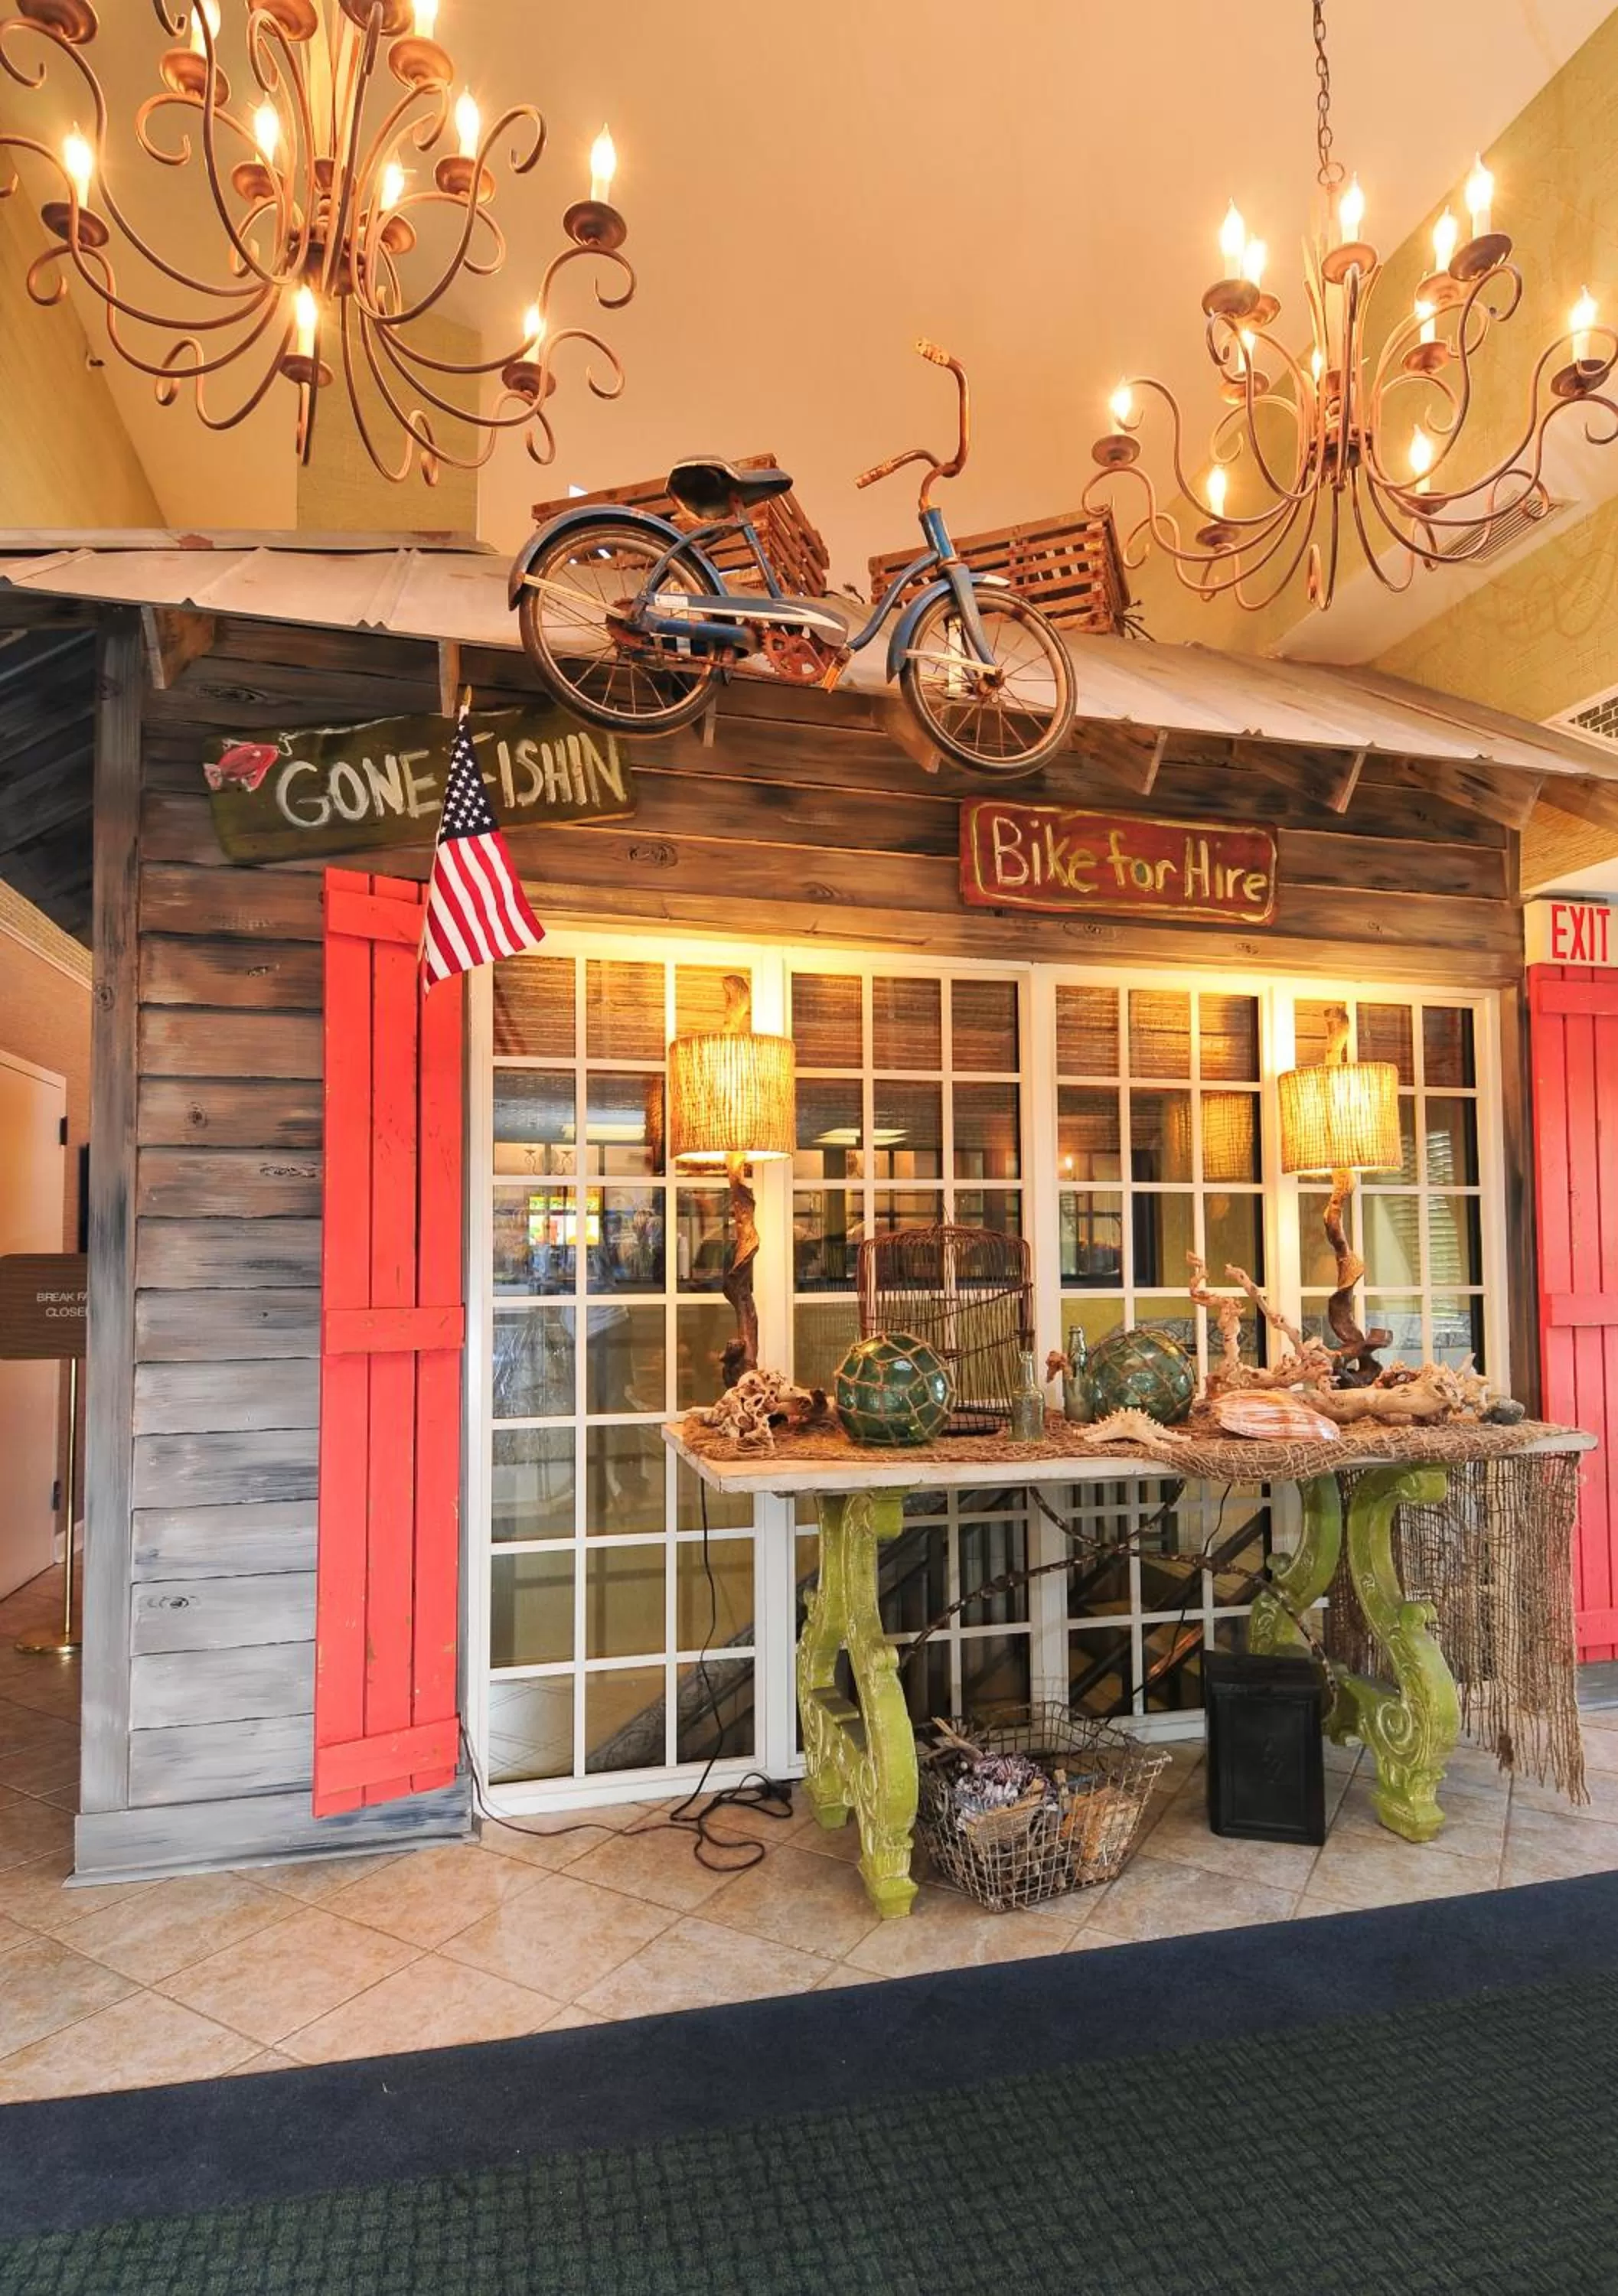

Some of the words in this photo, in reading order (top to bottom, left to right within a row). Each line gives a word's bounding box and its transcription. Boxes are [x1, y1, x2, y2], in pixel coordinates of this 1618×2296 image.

[276, 750, 444, 828] GONE
[993, 815, 1098, 893] Bike
[1107, 829, 1177, 893] for
[1184, 836, 1268, 902] Hire
[1551, 904, 1611, 962] EXIT
